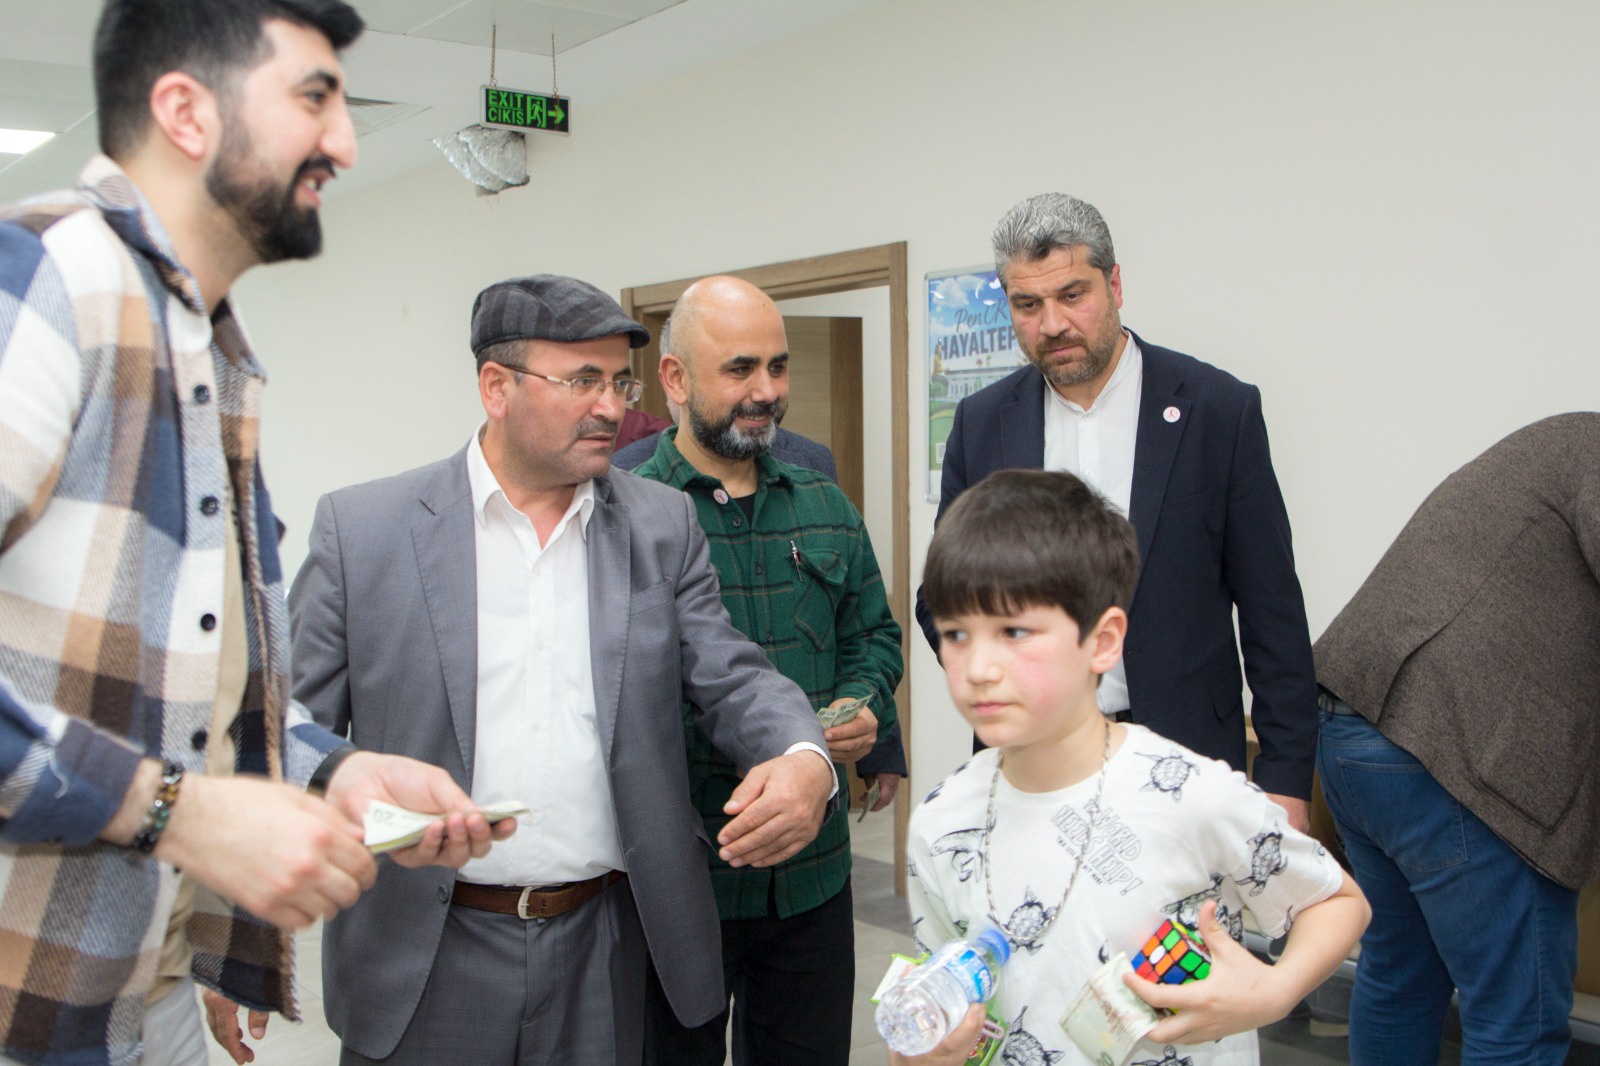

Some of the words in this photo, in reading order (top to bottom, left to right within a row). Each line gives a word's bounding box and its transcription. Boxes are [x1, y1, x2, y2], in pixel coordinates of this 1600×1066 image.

[489, 90, 524, 109] EXIT
[1051, 804, 1104, 854] NEEDS
[1088, 844, 1144, 896] HELP!
[1093, 807, 1142, 861] WORLD
